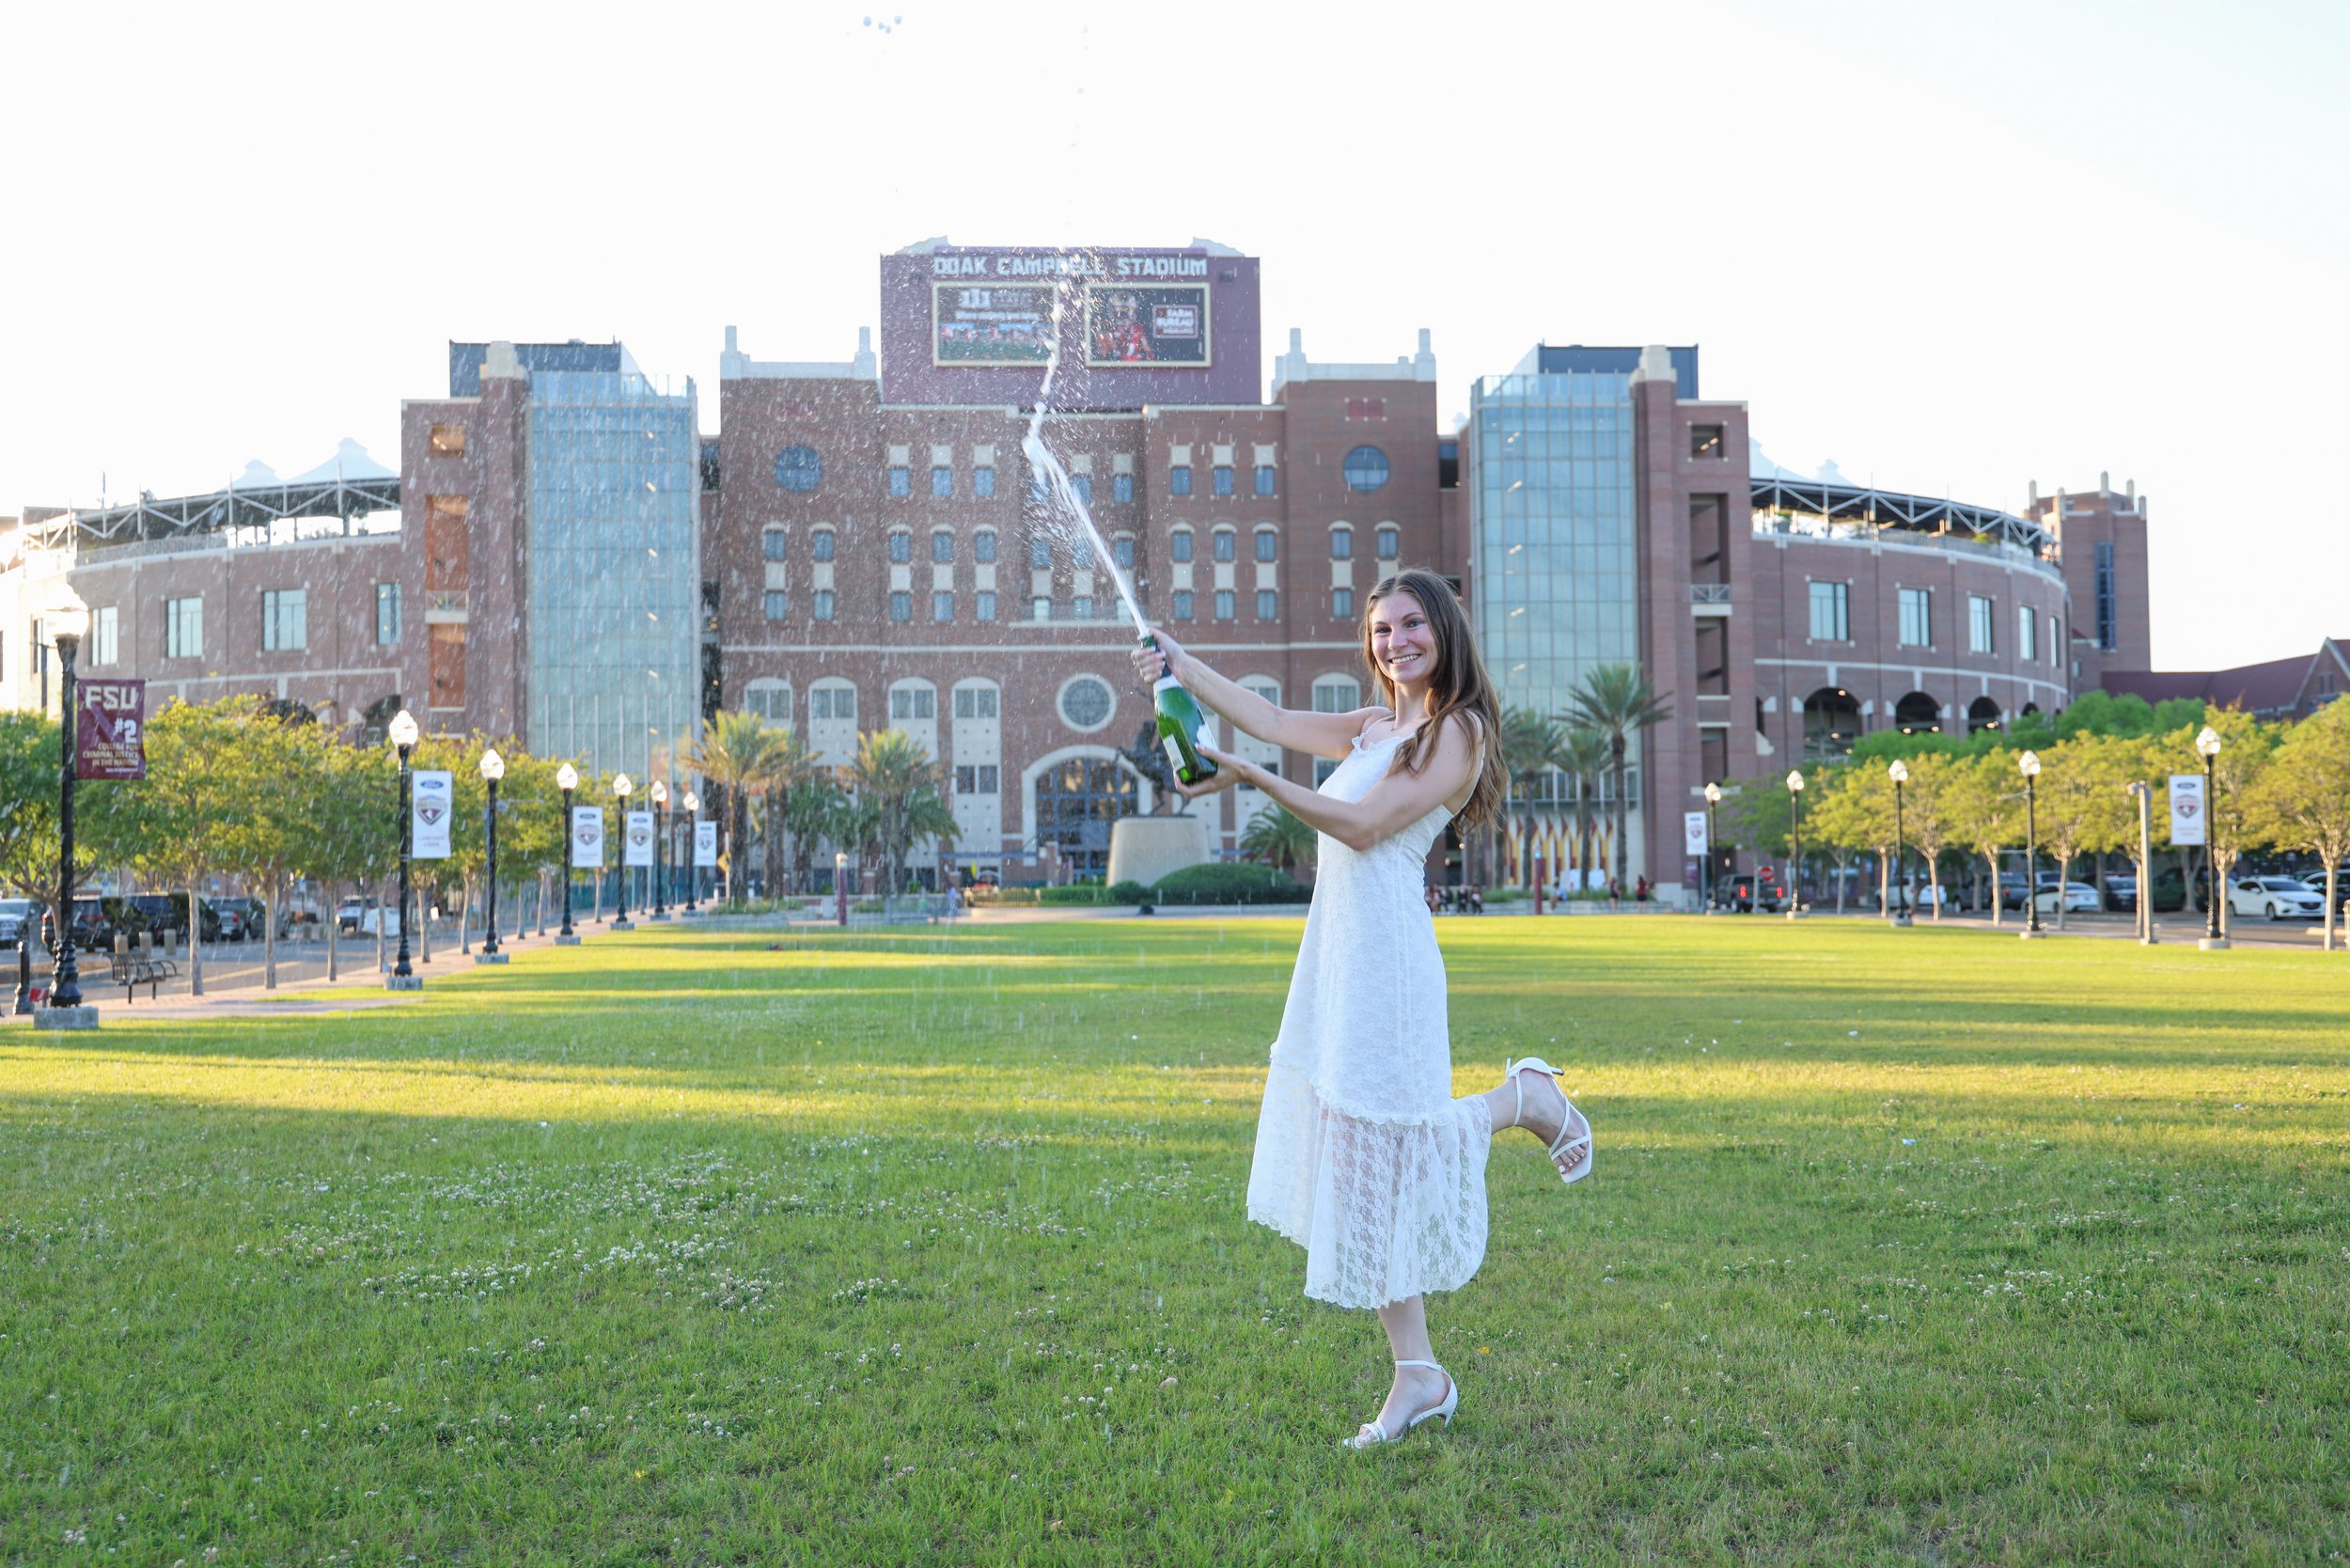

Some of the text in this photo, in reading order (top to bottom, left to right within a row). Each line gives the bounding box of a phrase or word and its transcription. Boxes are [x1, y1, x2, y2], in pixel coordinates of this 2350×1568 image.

[933, 257, 987, 274] DOAK
[1117, 257, 1207, 275] STADIUM
[86, 685, 137, 710] FSU
[115, 717, 136, 744] #2
[98, 742, 124, 750] COLLEGE
[83, 750, 139, 759] CRIMINAL JUSTICE
[92, 759, 139, 767] IN THE NATION
